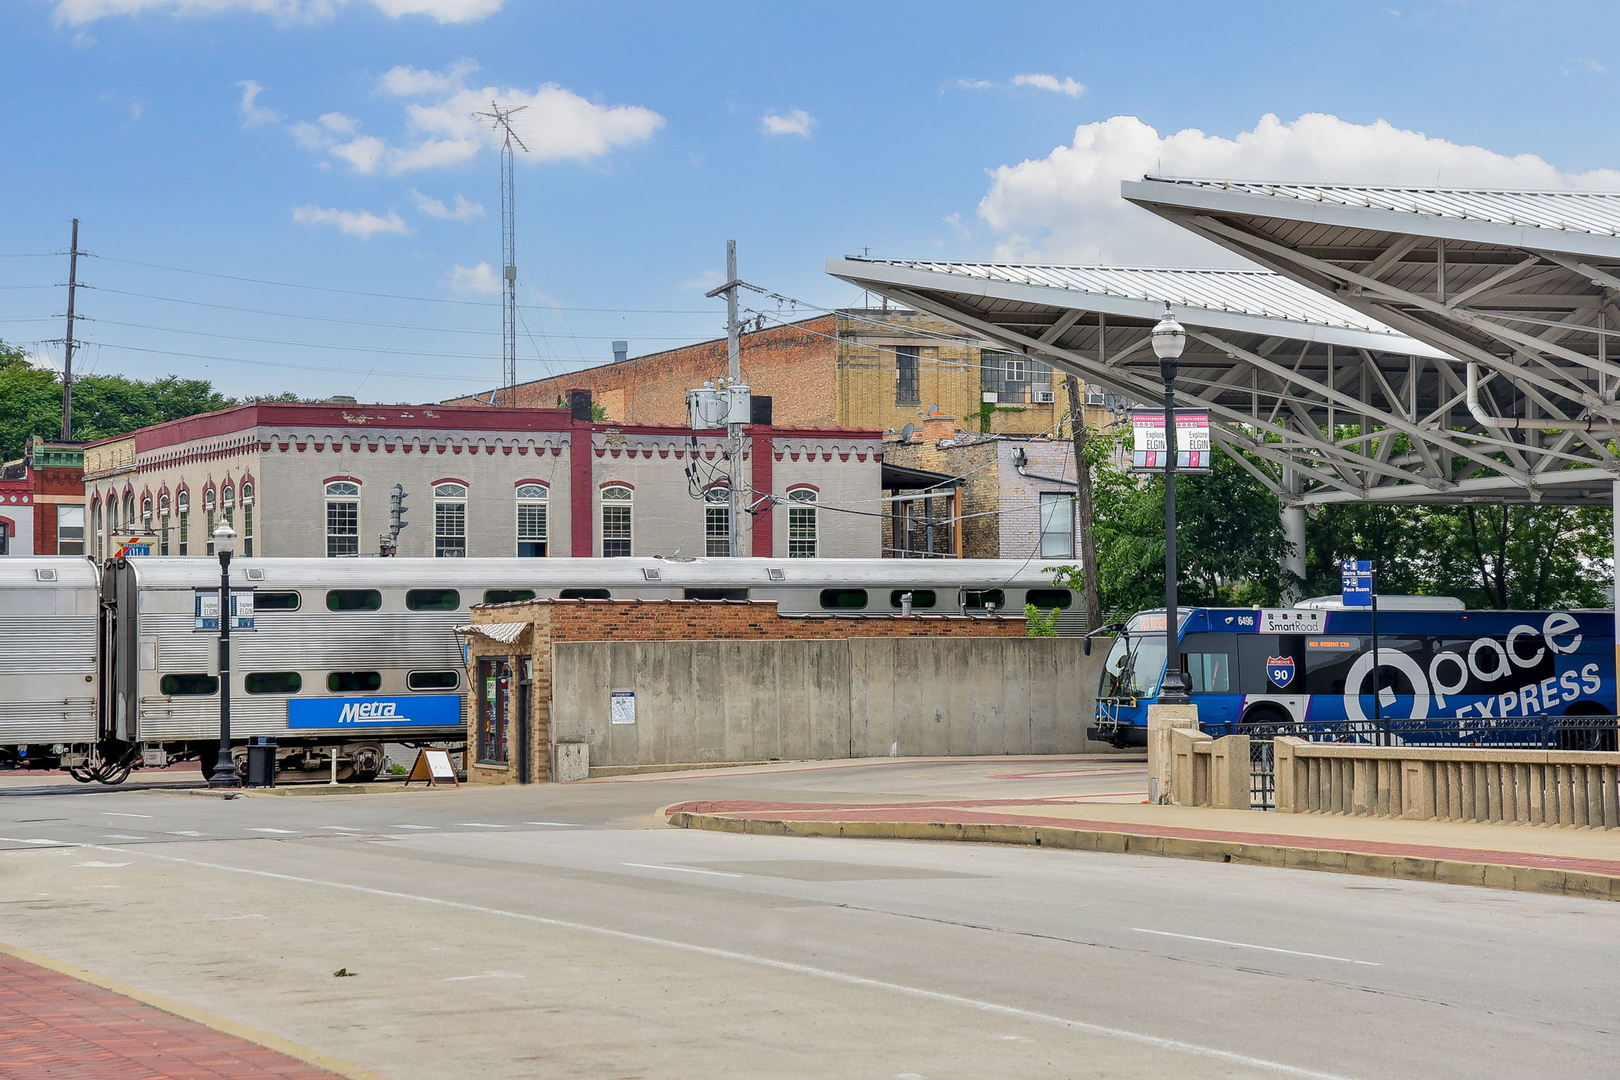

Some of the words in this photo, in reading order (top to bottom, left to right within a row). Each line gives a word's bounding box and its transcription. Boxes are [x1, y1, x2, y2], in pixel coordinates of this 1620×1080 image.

[1145, 430, 1165, 439] Explore
[1188, 430, 1208, 439] Explore
[1146, 440, 1166, 449] ELGIN
[1189, 440, 1209, 449] ELGIN
[1237, 616, 1254, 626] 6496
[1269, 620, 1318, 631] SmartRoad
[1429, 612, 1583, 710] pace
[1274, 669, 1288, 680] 90
[1455, 662, 1601, 738] EXPRESS
[338, 701, 397, 723] Metra
